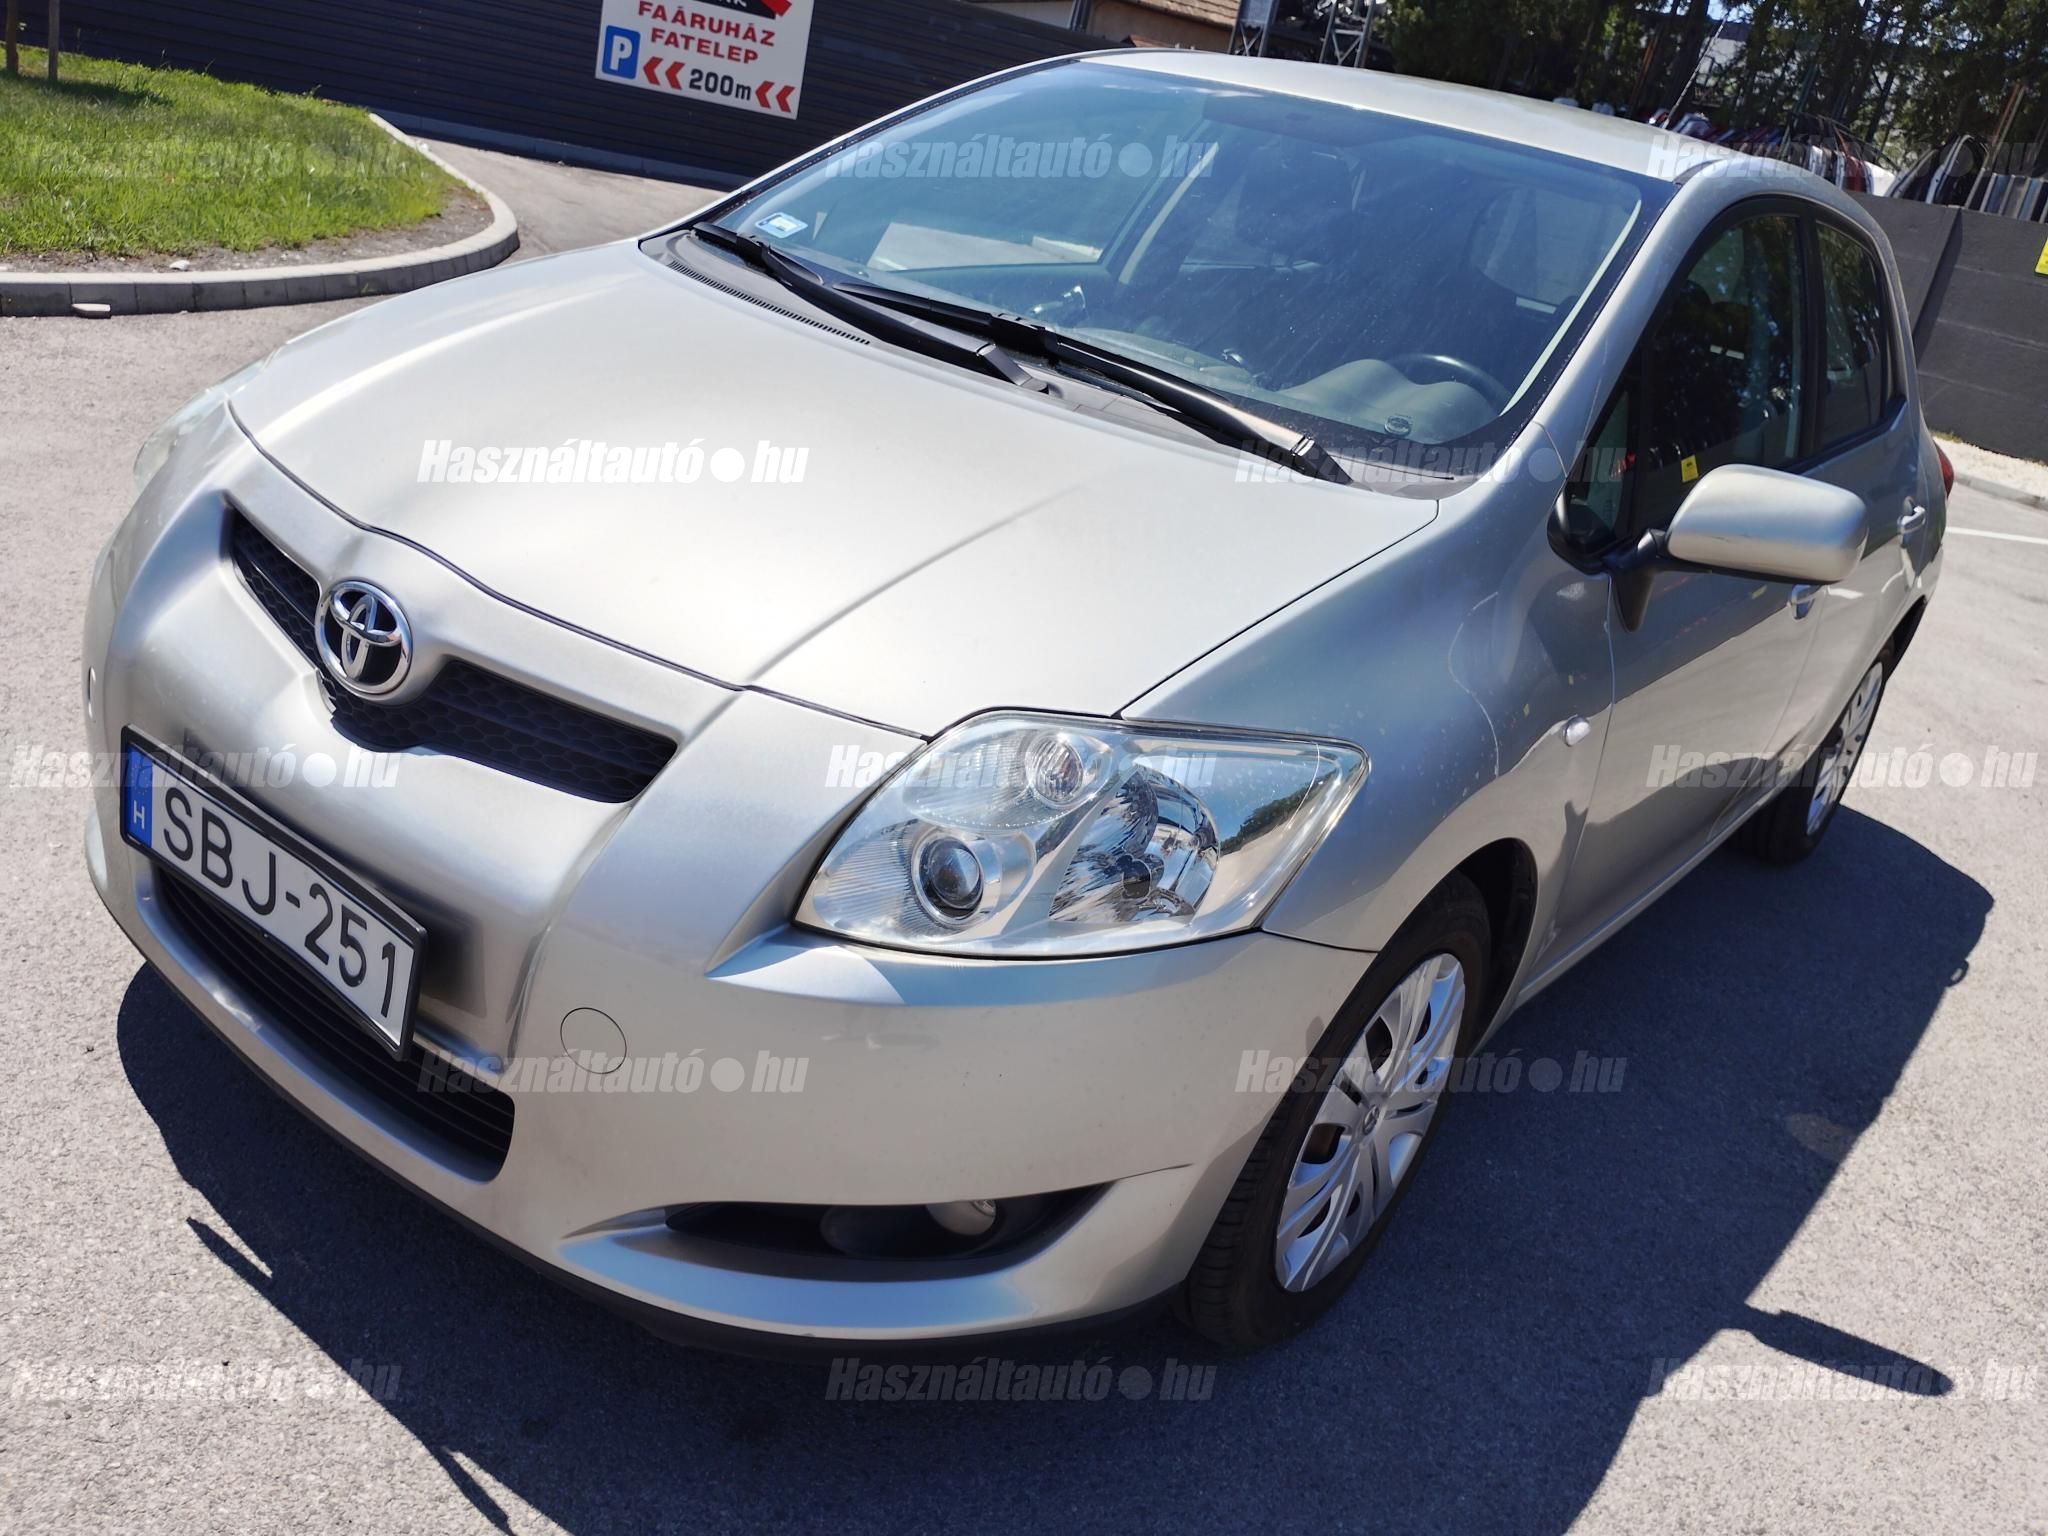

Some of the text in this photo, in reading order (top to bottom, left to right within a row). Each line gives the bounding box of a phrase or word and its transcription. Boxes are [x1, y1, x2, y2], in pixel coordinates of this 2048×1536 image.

[638, 1, 776, 47] FAÁRUHÁZ
[651, 27, 759, 64] FATELEP
[689, 69, 751, 101] 200m
[164, 787, 396, 1018] SBJ-251
